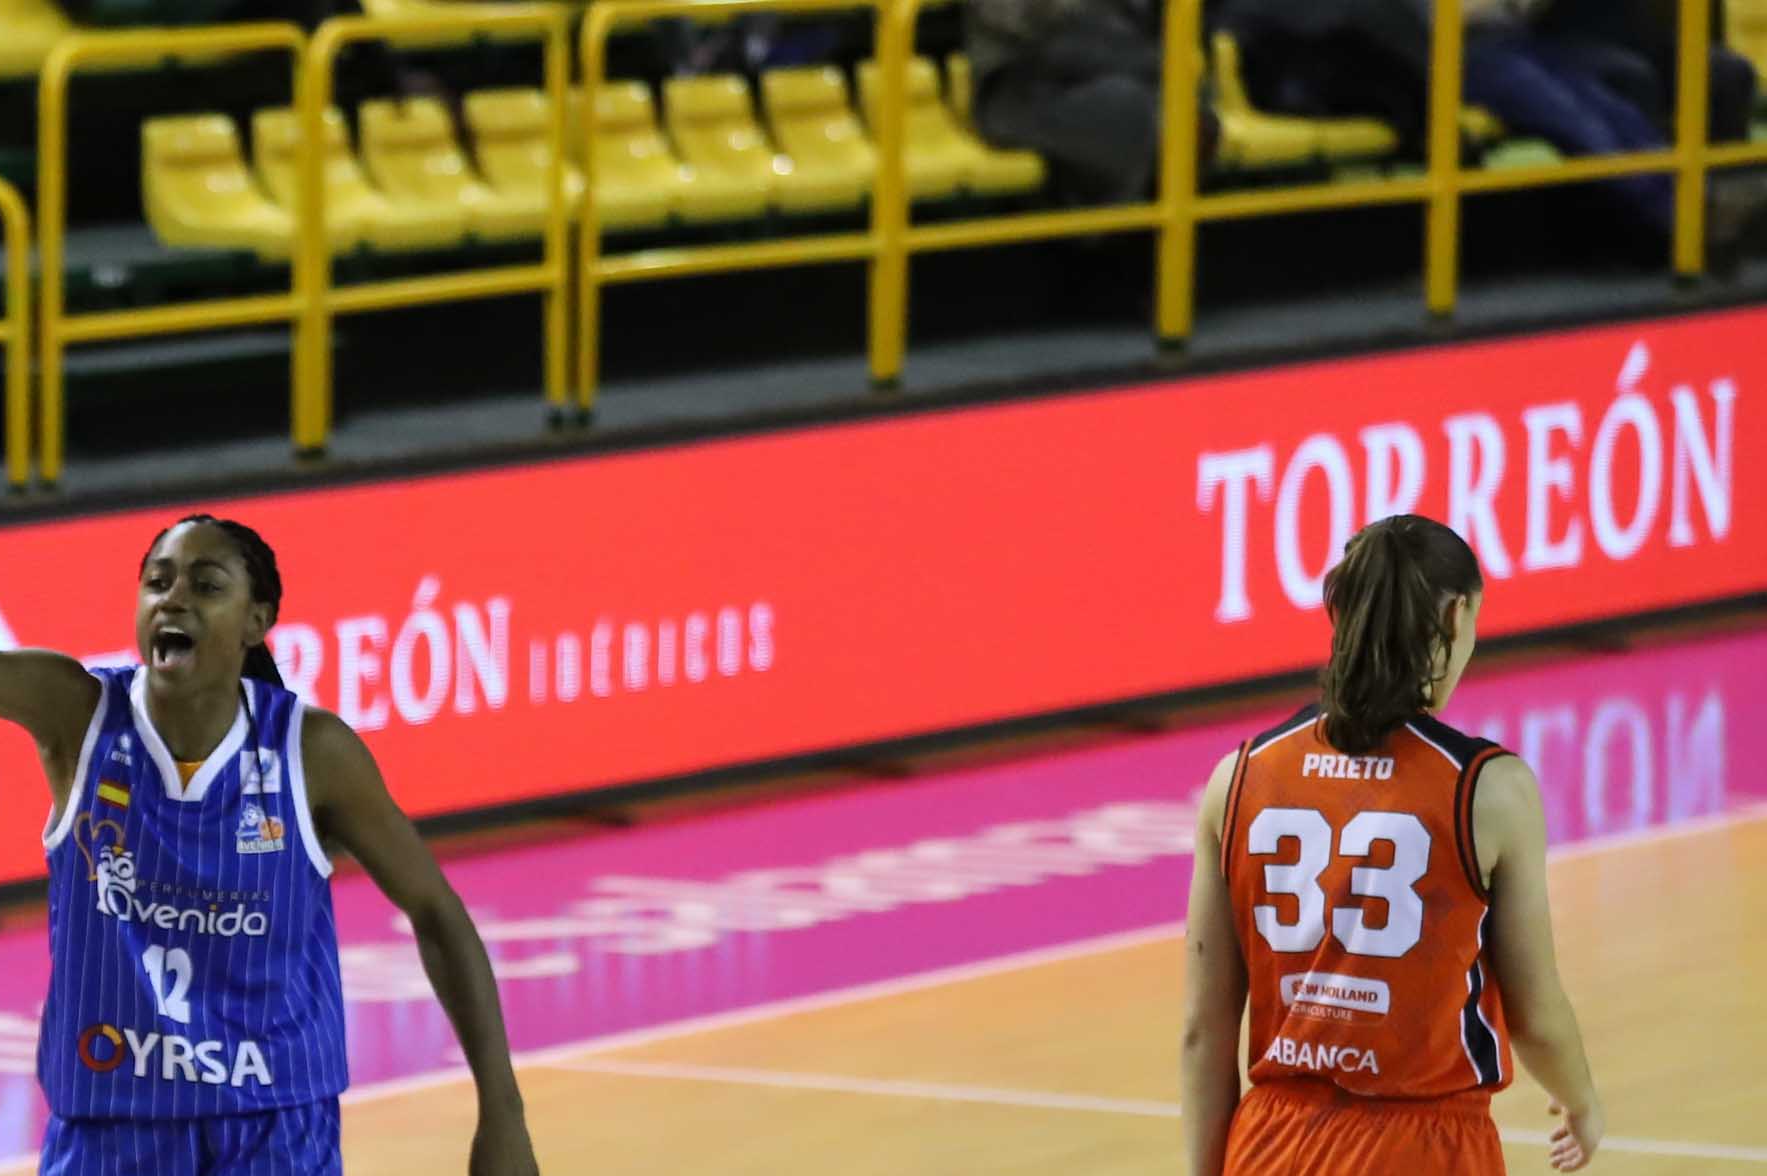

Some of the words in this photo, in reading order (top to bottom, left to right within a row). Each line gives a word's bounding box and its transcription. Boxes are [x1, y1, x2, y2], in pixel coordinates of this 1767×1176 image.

[1302, 753, 1395, 781] PRIETO
[1247, 807, 1432, 959] 33
[141, 943, 193, 1025] 12
[1267, 1035, 1380, 1075] ABANCA
